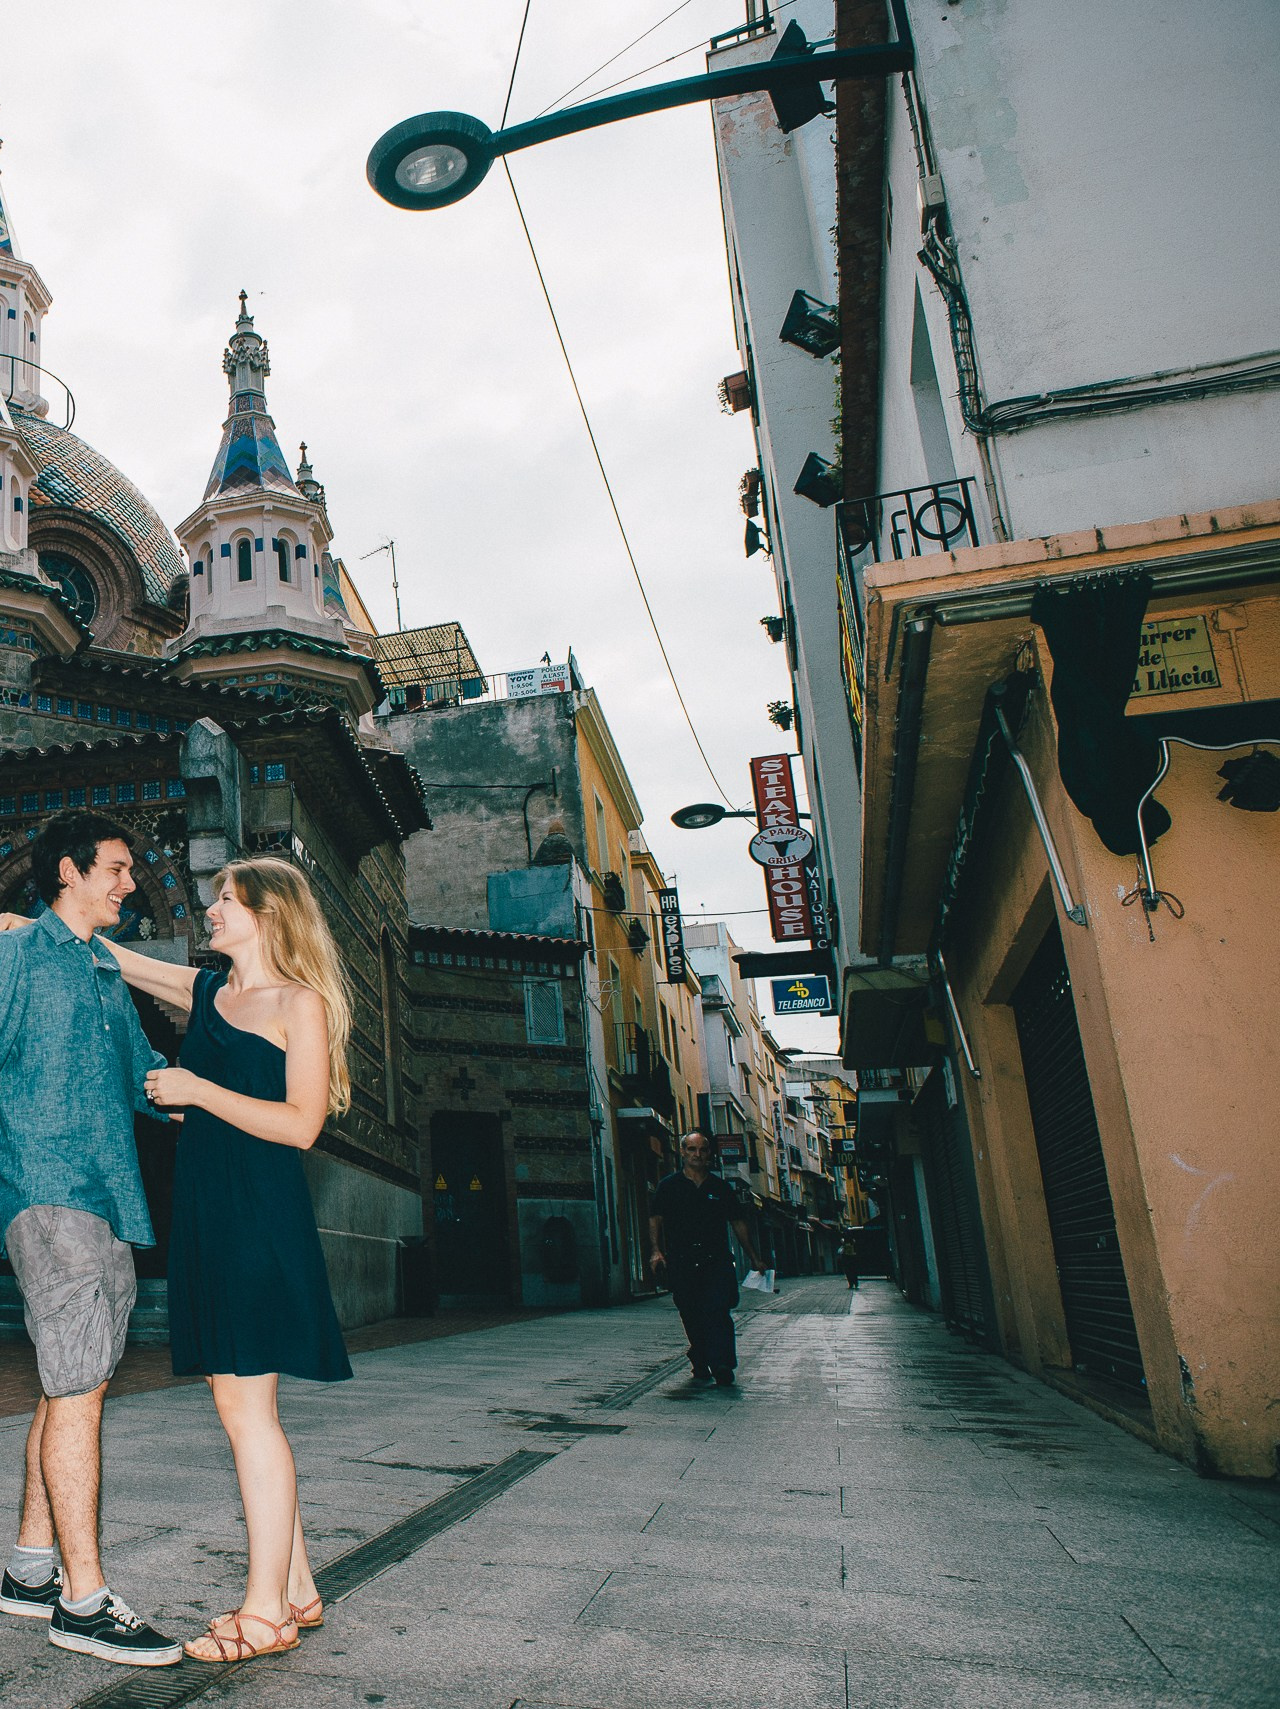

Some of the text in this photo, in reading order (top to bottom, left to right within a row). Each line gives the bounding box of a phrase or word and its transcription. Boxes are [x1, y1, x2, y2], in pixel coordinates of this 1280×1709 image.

[1138, 650, 1162, 667] de
[541, 665, 566, 673] POLLOS
[510, 674, 534, 683] YOYO
[1146, 665, 1215, 691] Llúcia
[760, 759, 794, 827] STEAK
[753, 828, 808, 846] LA PAMPA
[768, 854, 799, 864] GRILL
[770, 866, 805, 936] HOUSE
[777, 997, 825, 1010] TELEBANCO
